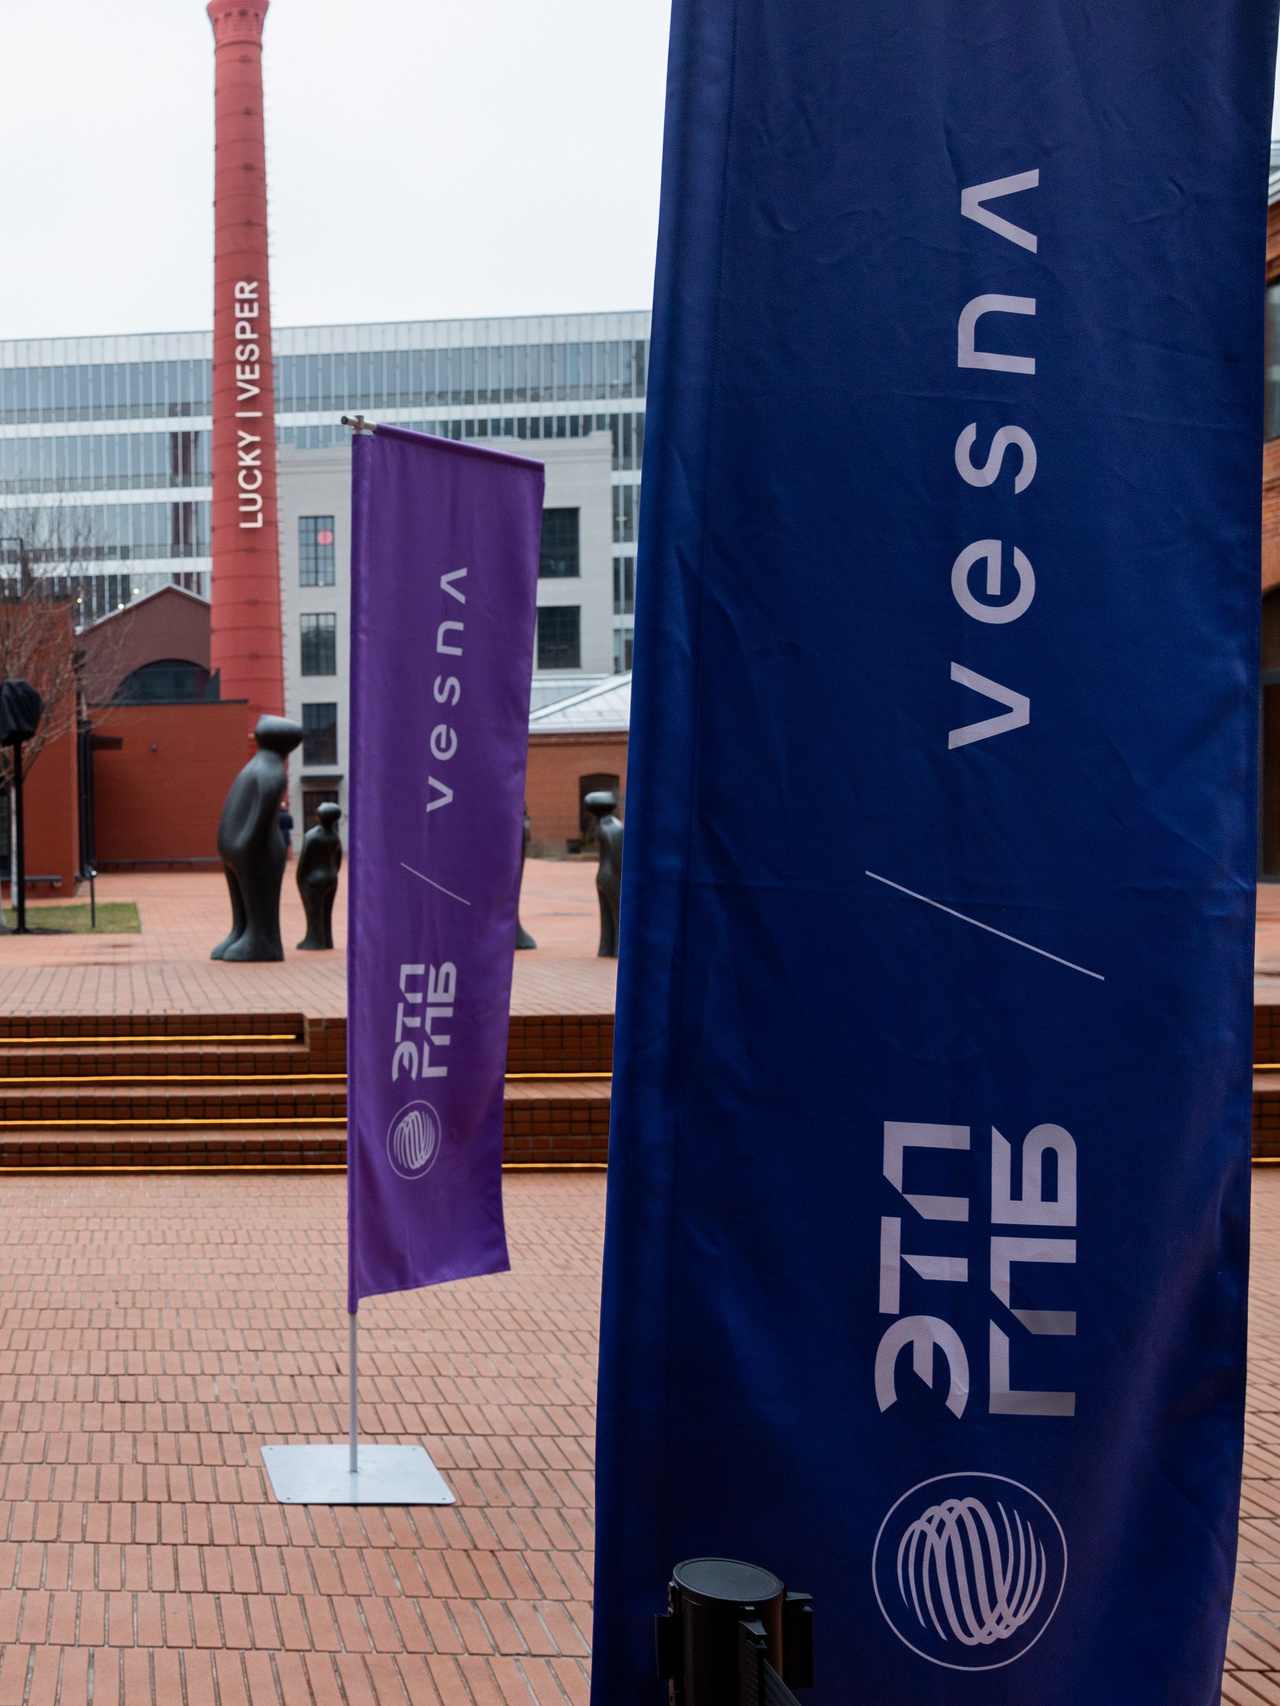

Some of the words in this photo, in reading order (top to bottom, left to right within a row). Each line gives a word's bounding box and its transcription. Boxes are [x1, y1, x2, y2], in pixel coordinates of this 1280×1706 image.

[234, 281, 261, 401] VESPER
[237, 430, 263, 529] LUCKY
[391, 964, 426, 1082] ЭТП
[421, 961, 457, 1078] ГПБ
[874, 1120, 971, 1419] ЭТП
[989, 1123, 1077, 1418] ГПБ
